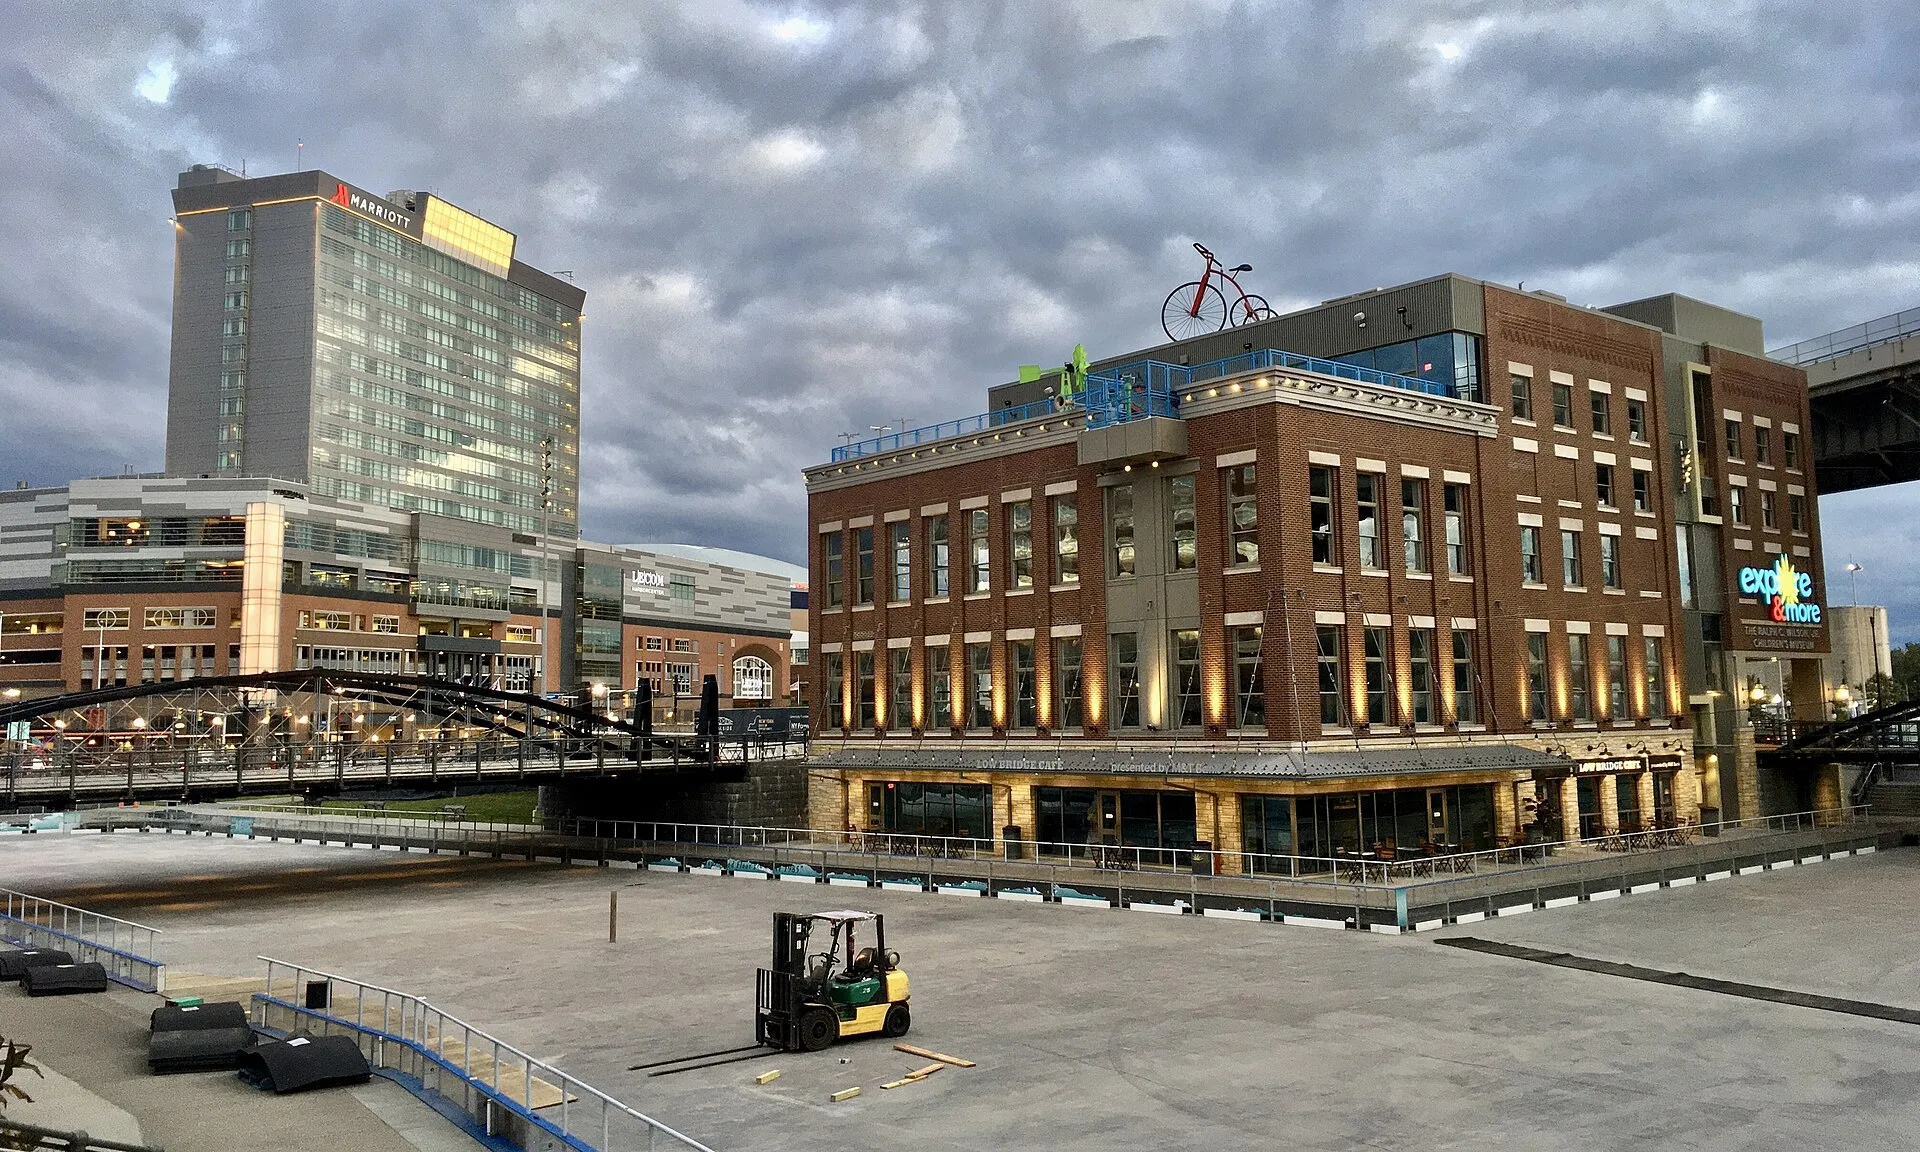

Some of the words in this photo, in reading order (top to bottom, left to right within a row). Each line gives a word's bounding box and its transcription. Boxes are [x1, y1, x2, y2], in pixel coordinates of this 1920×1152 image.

[351, 194, 410, 228] MARRIOTT
[1770, 596, 1786, 622] &
[1786, 602, 1821, 622] more
[1744, 626, 1757, 636] THE
[1757, 626, 1777, 636] RALPH
[1753, 638, 1788, 649] CHILDREN'S
[1789, 640, 1815, 650] MUSEUM
[977, 759, 997, 769] LOW
[999, 760, 1036, 769] BRIDGE
[1111, 762, 1156, 773] presented
[1158, 763, 1169, 774] by
[1171, 763, 1196, 773] M&T
[1579, 762, 1595, 772] LOW
[1596, 761, 1623, 771] BRIDGE
